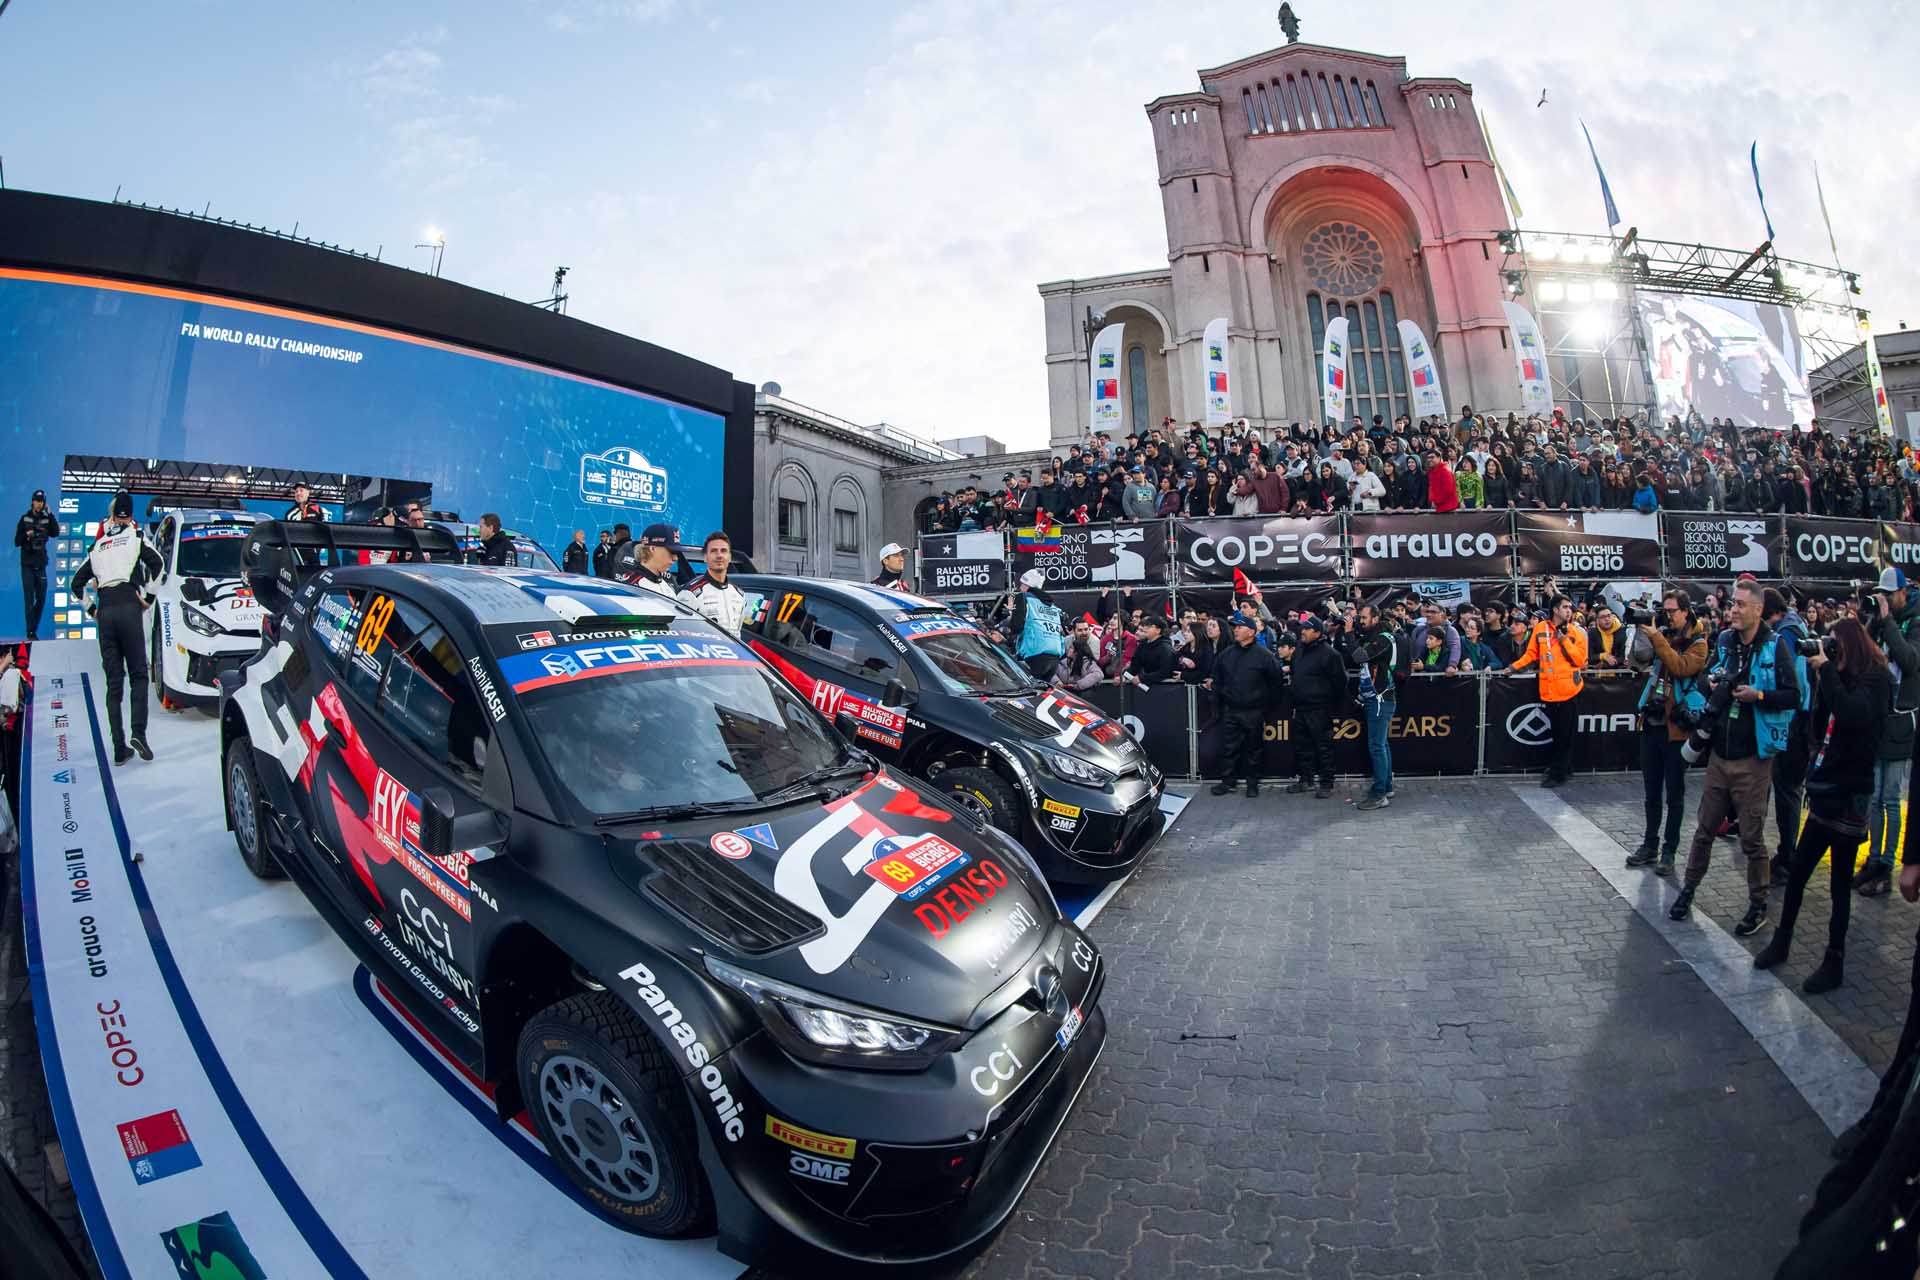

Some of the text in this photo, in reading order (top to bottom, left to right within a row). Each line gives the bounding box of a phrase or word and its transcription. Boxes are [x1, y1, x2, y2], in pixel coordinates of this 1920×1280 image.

[181, 322, 363, 364] FIA WORLD RALLY CHAMPIONSHIP
[611, 468, 653, 483] RALLYCHILE
[1683, 521, 1726, 533] GOBIERNO
[1684, 532, 1727, 543] REGIONAL
[1190, 533, 1328, 567] COPEC
[1365, 531, 1498, 559] arauco
[1560, 544, 1623, 557] RALLYCHILE
[1684, 544, 1727, 553] REGION DEL
[1796, 533, 1873, 564] COPEC
[936, 564, 990, 576] RALLYCHILE
[1035, 555, 1088, 567] REGION DEL
[1685, 554, 1728, 569] BIOBIO
[776, 592, 804, 624] 17
[357, 595, 395, 656] 69
[521, 636, 554, 648] GR
[558, 629, 626, 643] TOYOTA
[628, 629, 679, 642] GAZOO
[876, 623, 908, 654] AsahiKASEI
[574, 643, 739, 668] FORUM8
[468, 655, 507, 722] AsahiKASEI
[813, 682, 843, 714] HY
[858, 726, 897, 746] L-FREE FUEL
[906, 717, 927, 729] PIAA
[1263, 719, 1289, 741] bil
[1388, 714, 1452, 738] EARS
[990, 740, 1038, 809] Panasonic
[374, 771, 407, 838] HY
[1051, 817, 1076, 831] OMP
[69, 861, 94, 904] Mobil
[407, 857, 457, 906] FOSSIL-FREE
[882, 861, 915, 883] 69
[470, 880, 499, 913] PIAA
[913, 859, 1008, 941] DENSO
[79, 915, 108, 978] arauco
[364, 917, 480, 1033] GR TOYOTA GAZOO Racing
[97, 999, 144, 1087] COPEC
[617, 962, 745, 1143] Panasonic
[771, 1121, 848, 1155] PIRELLI
[789, 1156, 850, 1182] OMP
